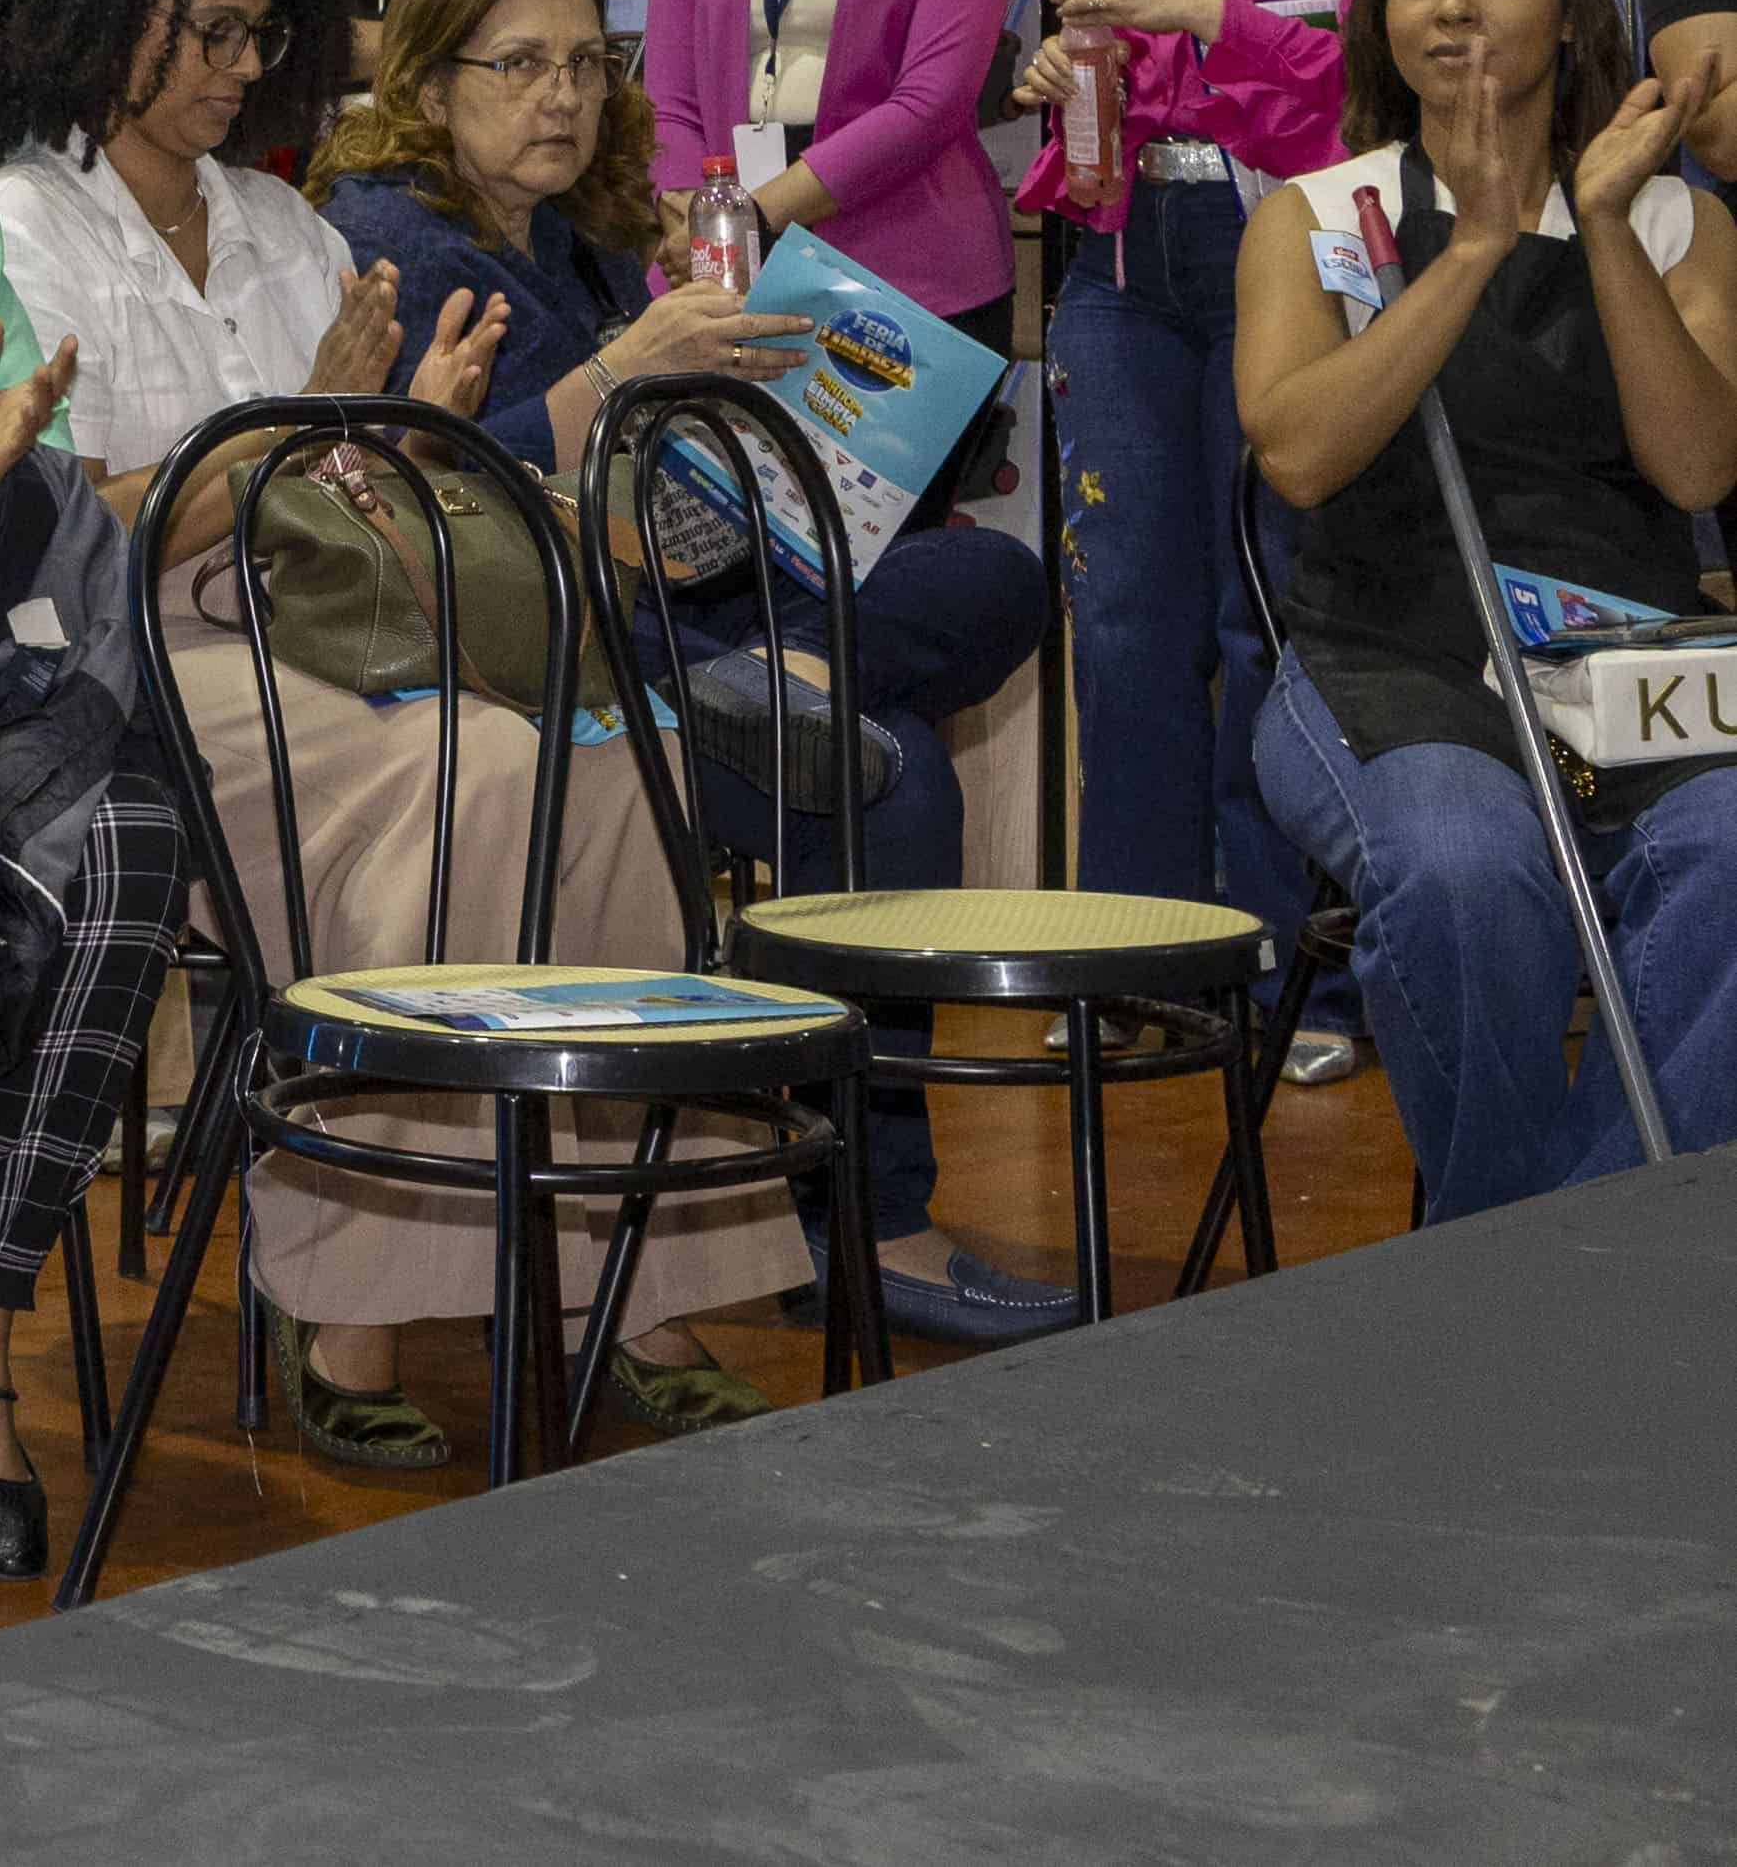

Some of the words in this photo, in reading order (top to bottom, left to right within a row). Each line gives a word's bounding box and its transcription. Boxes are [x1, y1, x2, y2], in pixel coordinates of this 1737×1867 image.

[853, 313, 907, 352] FERIA
[864, 335, 886, 352] DE
[806, 379, 858, 427] LIMPIA
